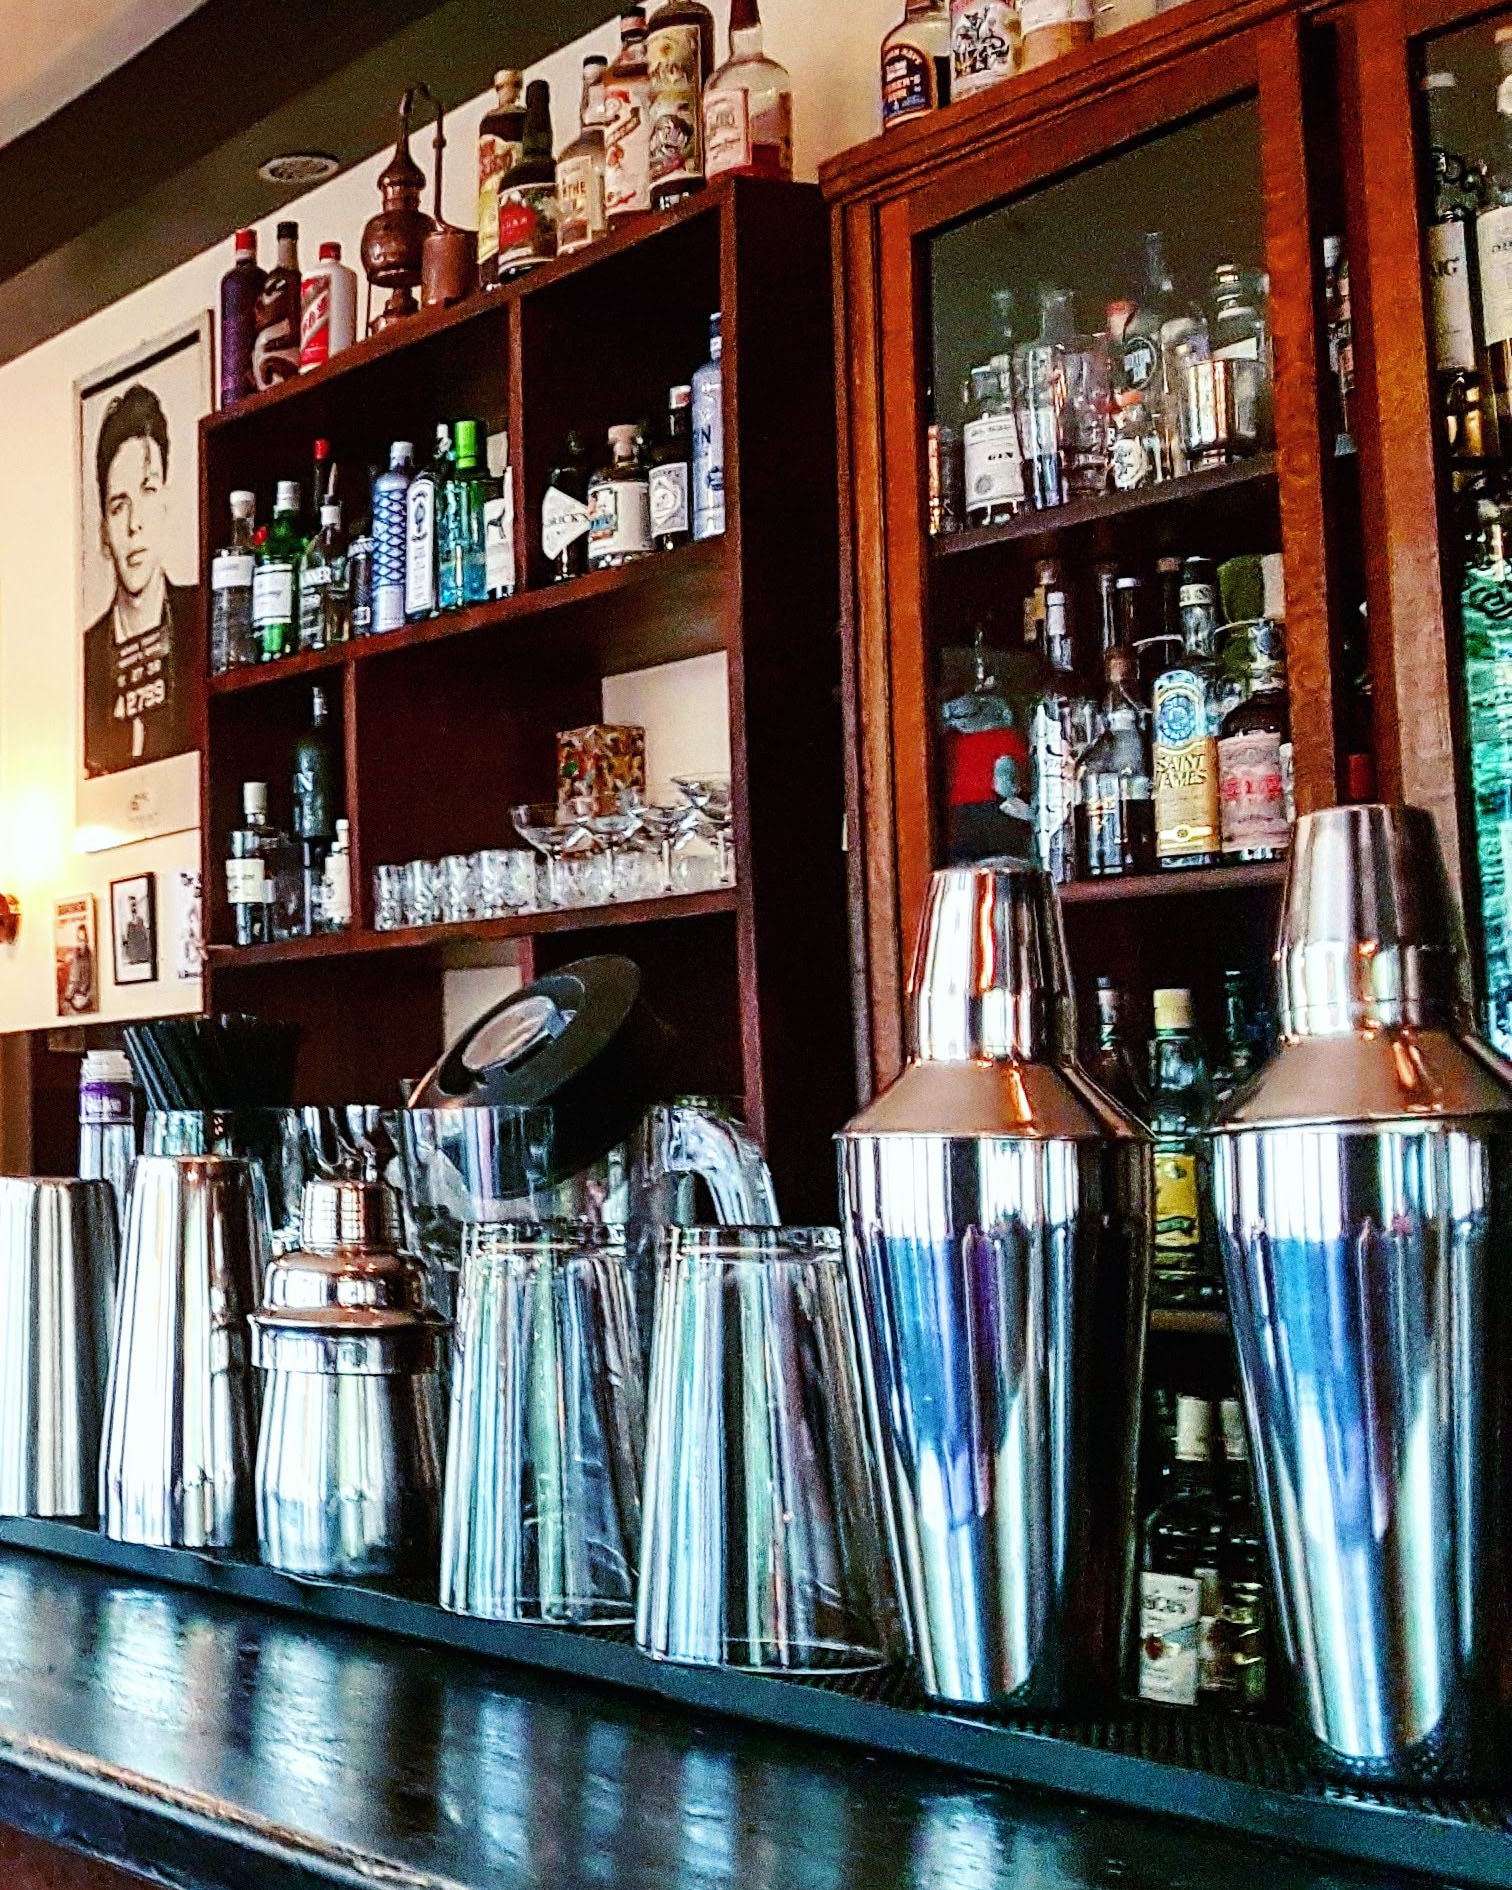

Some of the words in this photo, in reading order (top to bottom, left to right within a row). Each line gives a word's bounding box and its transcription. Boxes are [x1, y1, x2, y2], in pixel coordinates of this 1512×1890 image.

[988, 451, 1014, 461] GIN
[1156, 753, 1205, 773] SAINT
[1157, 768, 1208, 791] JAMES
